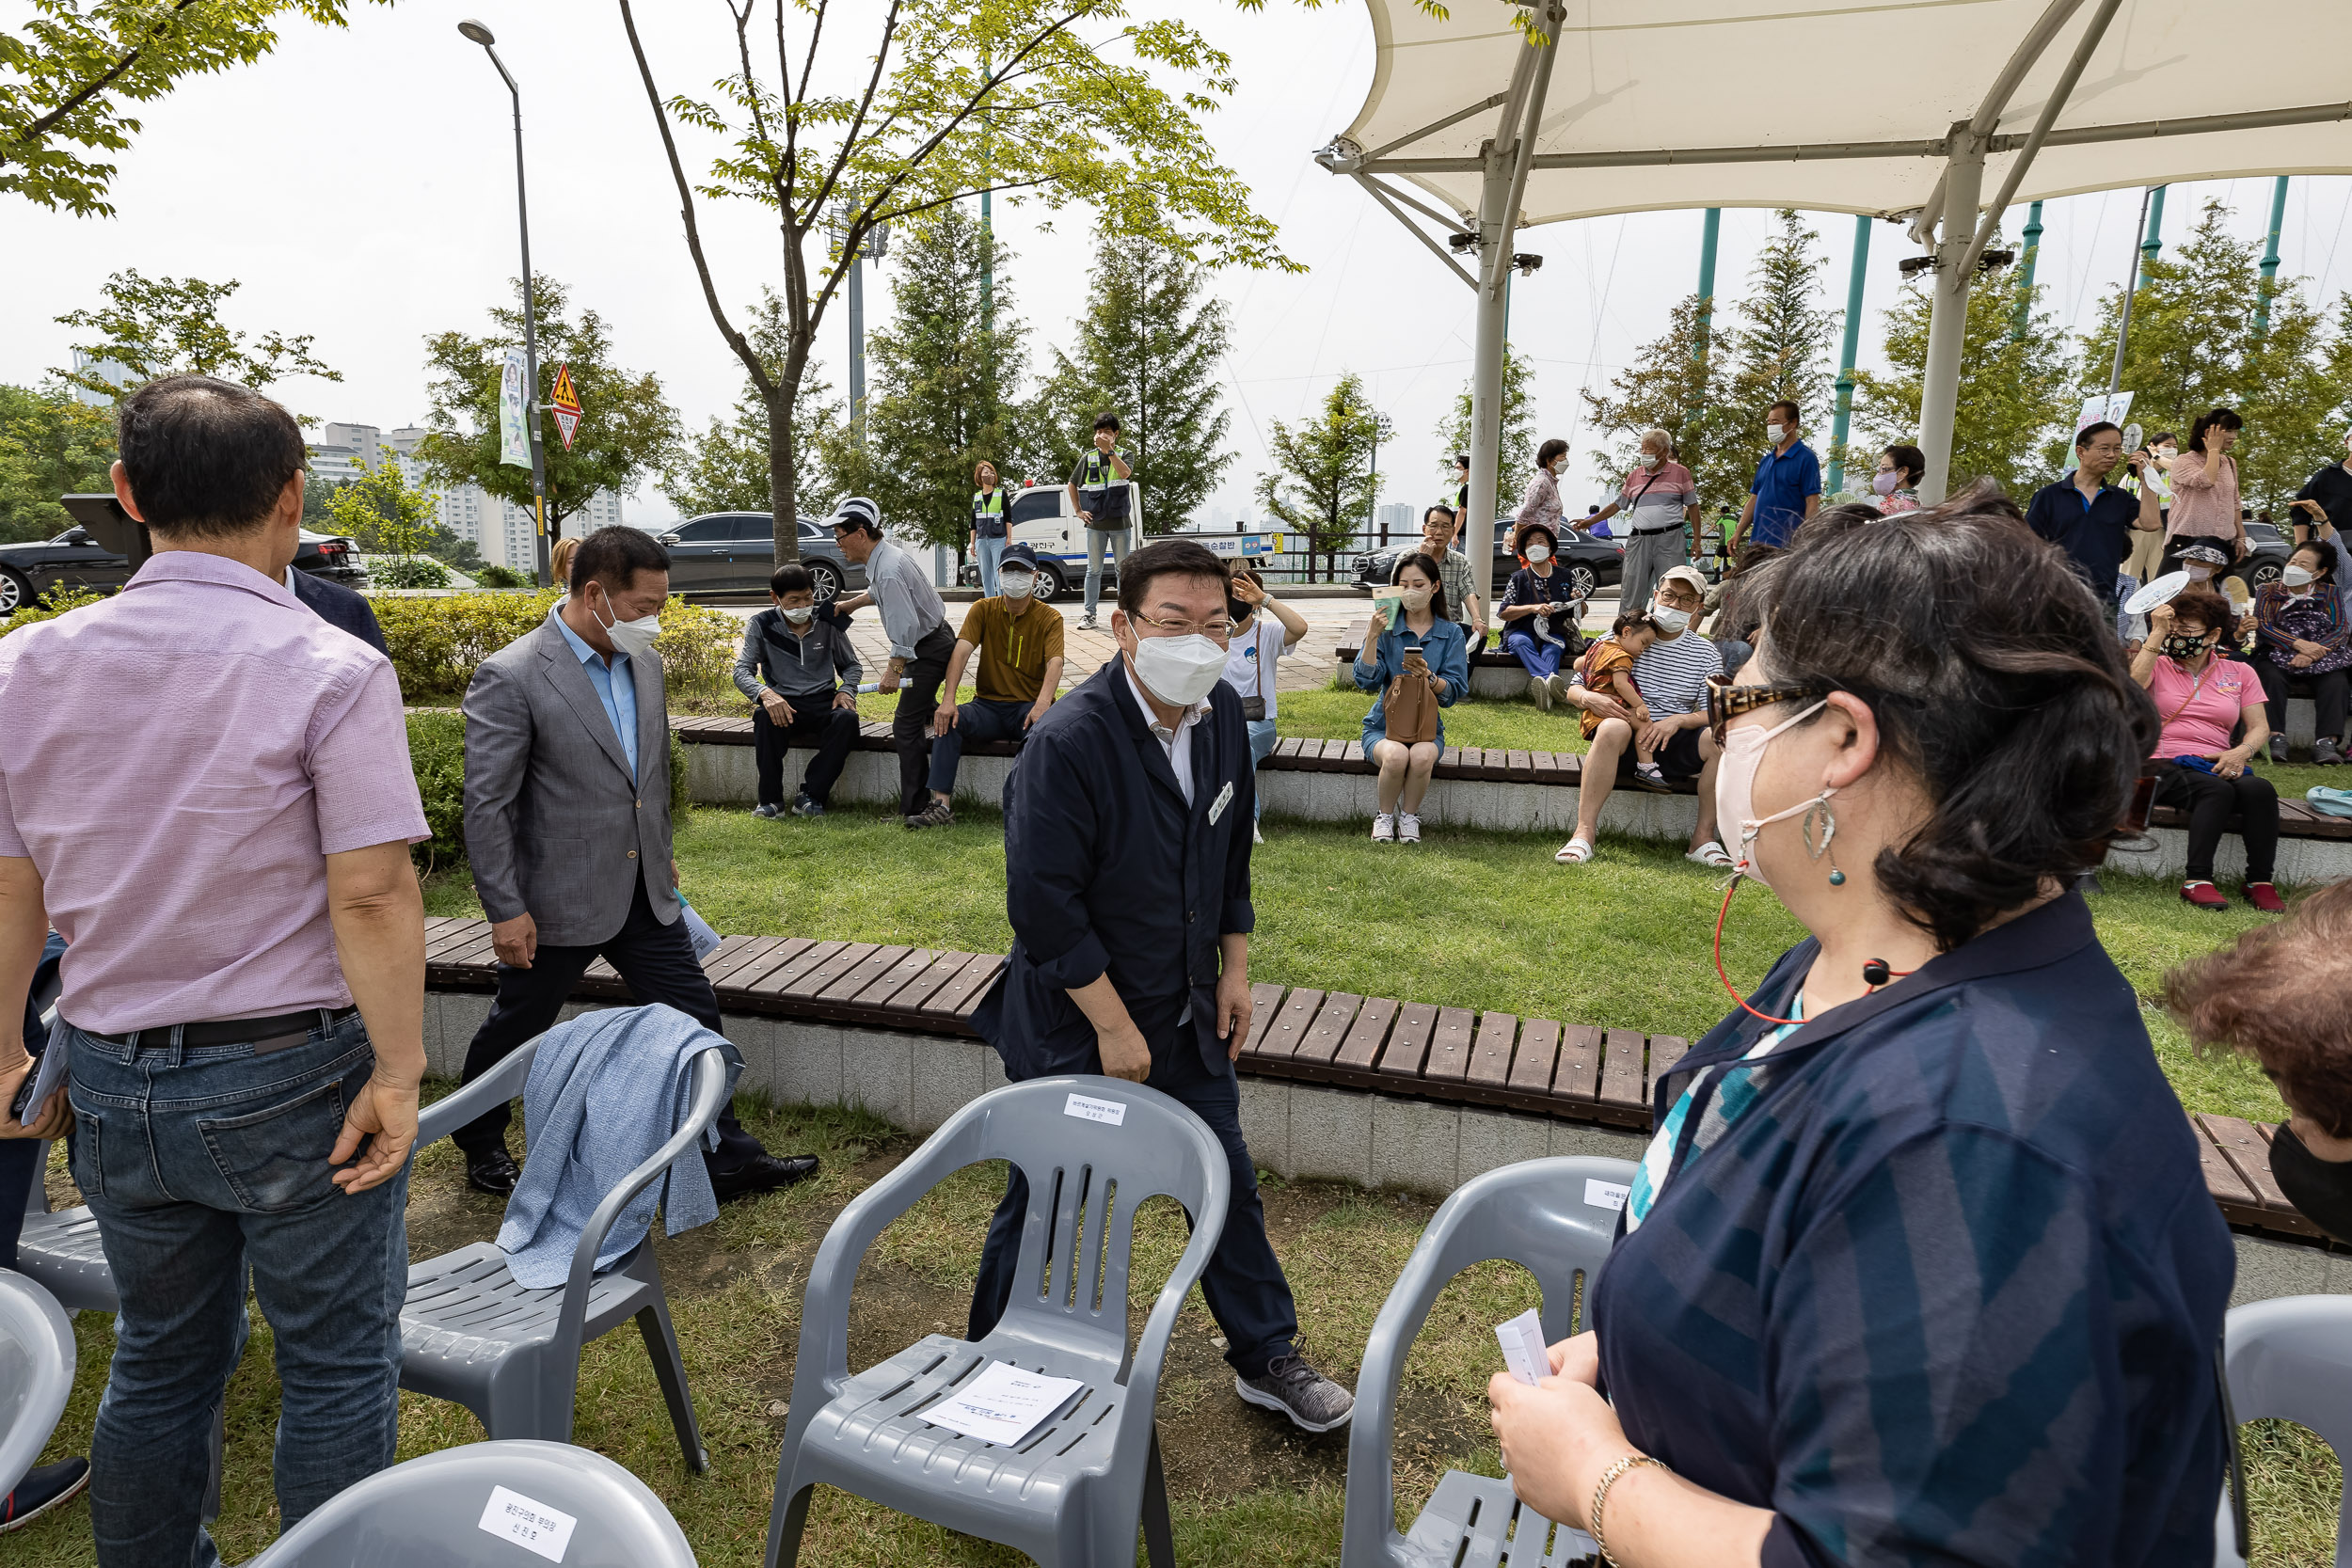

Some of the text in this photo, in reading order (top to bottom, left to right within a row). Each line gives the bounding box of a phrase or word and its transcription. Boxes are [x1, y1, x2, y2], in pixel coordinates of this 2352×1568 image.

[1029, 542, 1056, 550] 광진구
[505, 1503, 557, 1532] 광진구의회 부의장
